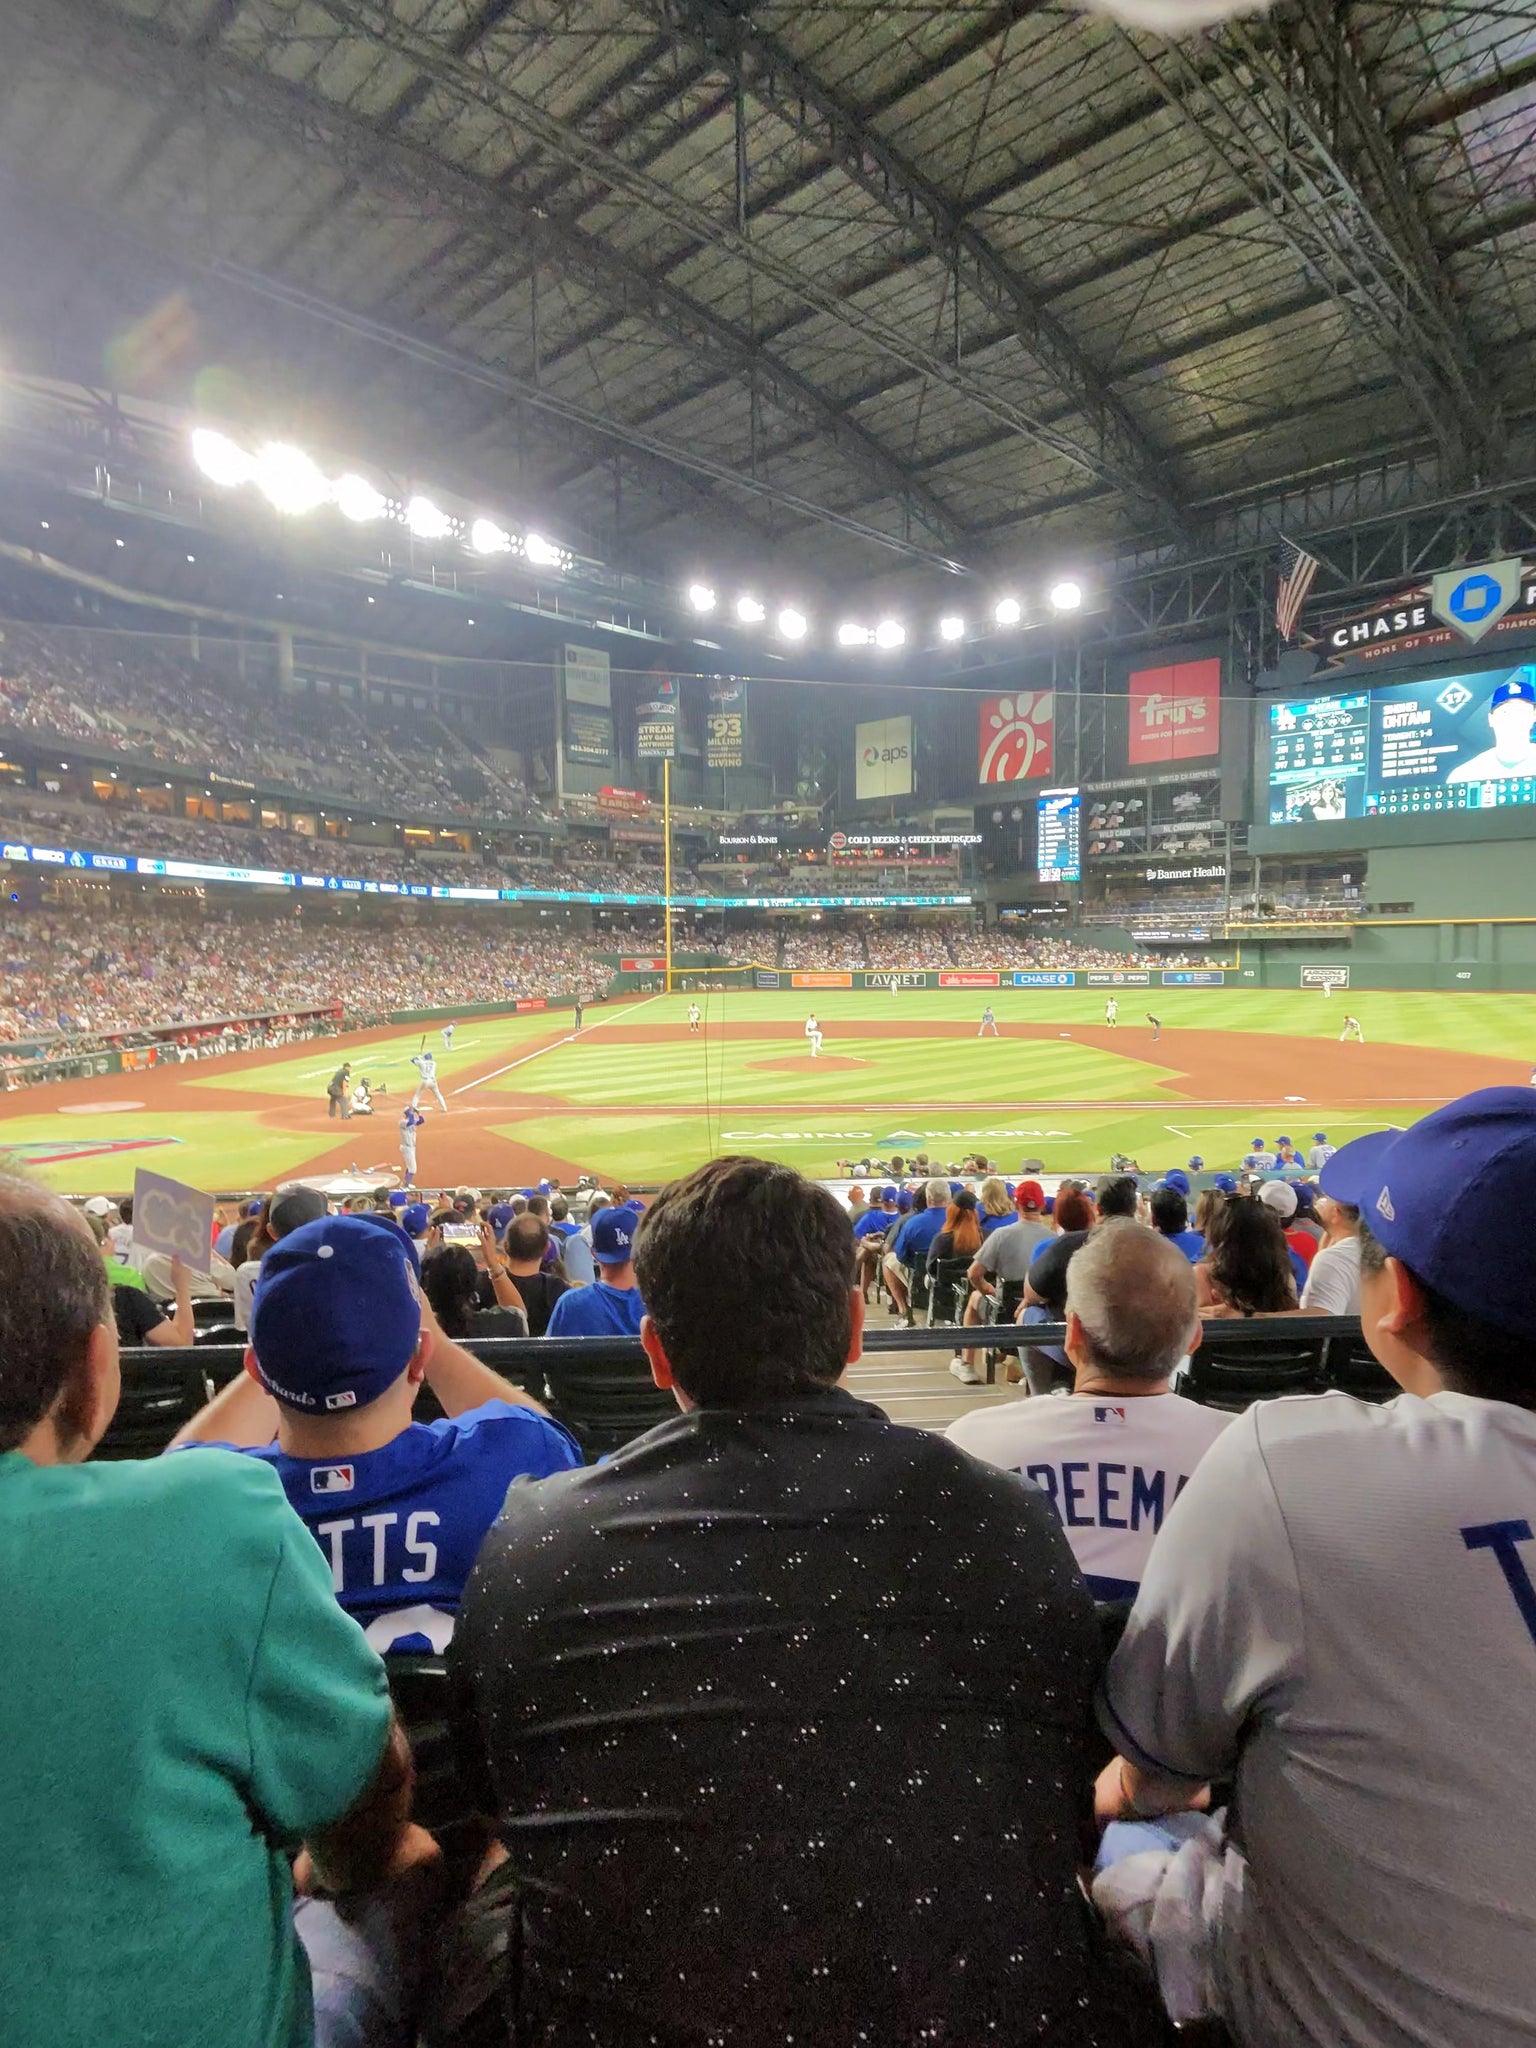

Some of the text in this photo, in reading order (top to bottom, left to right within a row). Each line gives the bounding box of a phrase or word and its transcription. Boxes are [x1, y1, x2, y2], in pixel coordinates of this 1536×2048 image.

[1333, 608, 1426, 647] CHASE
[1365, 645, 1397, 659] HOME
[1405, 639, 1419, 648] OF
[1428, 632, 1452, 643] THE
[638, 725, 674, 734] STREAM
[881, 745, 908, 764] aps
[708, 758, 742, 767] GIVING
[848, 836, 871, 844] COLD
[872, 835, 900, 844] BEERS
[908, 835, 982, 845] CHEESEBURGERS
[1157, 865, 1226, 879] Banner Health
[872, 974, 919, 985] AVNET
[1021, 975, 1056, 983] CHASE
[721, 1129, 1072, 1140] CASINO ARIZONA
[614, 1228, 629, 1245] LA
[1008, 1462, 1190, 1535] REEM
[318, 1511, 441, 1593] TTS
